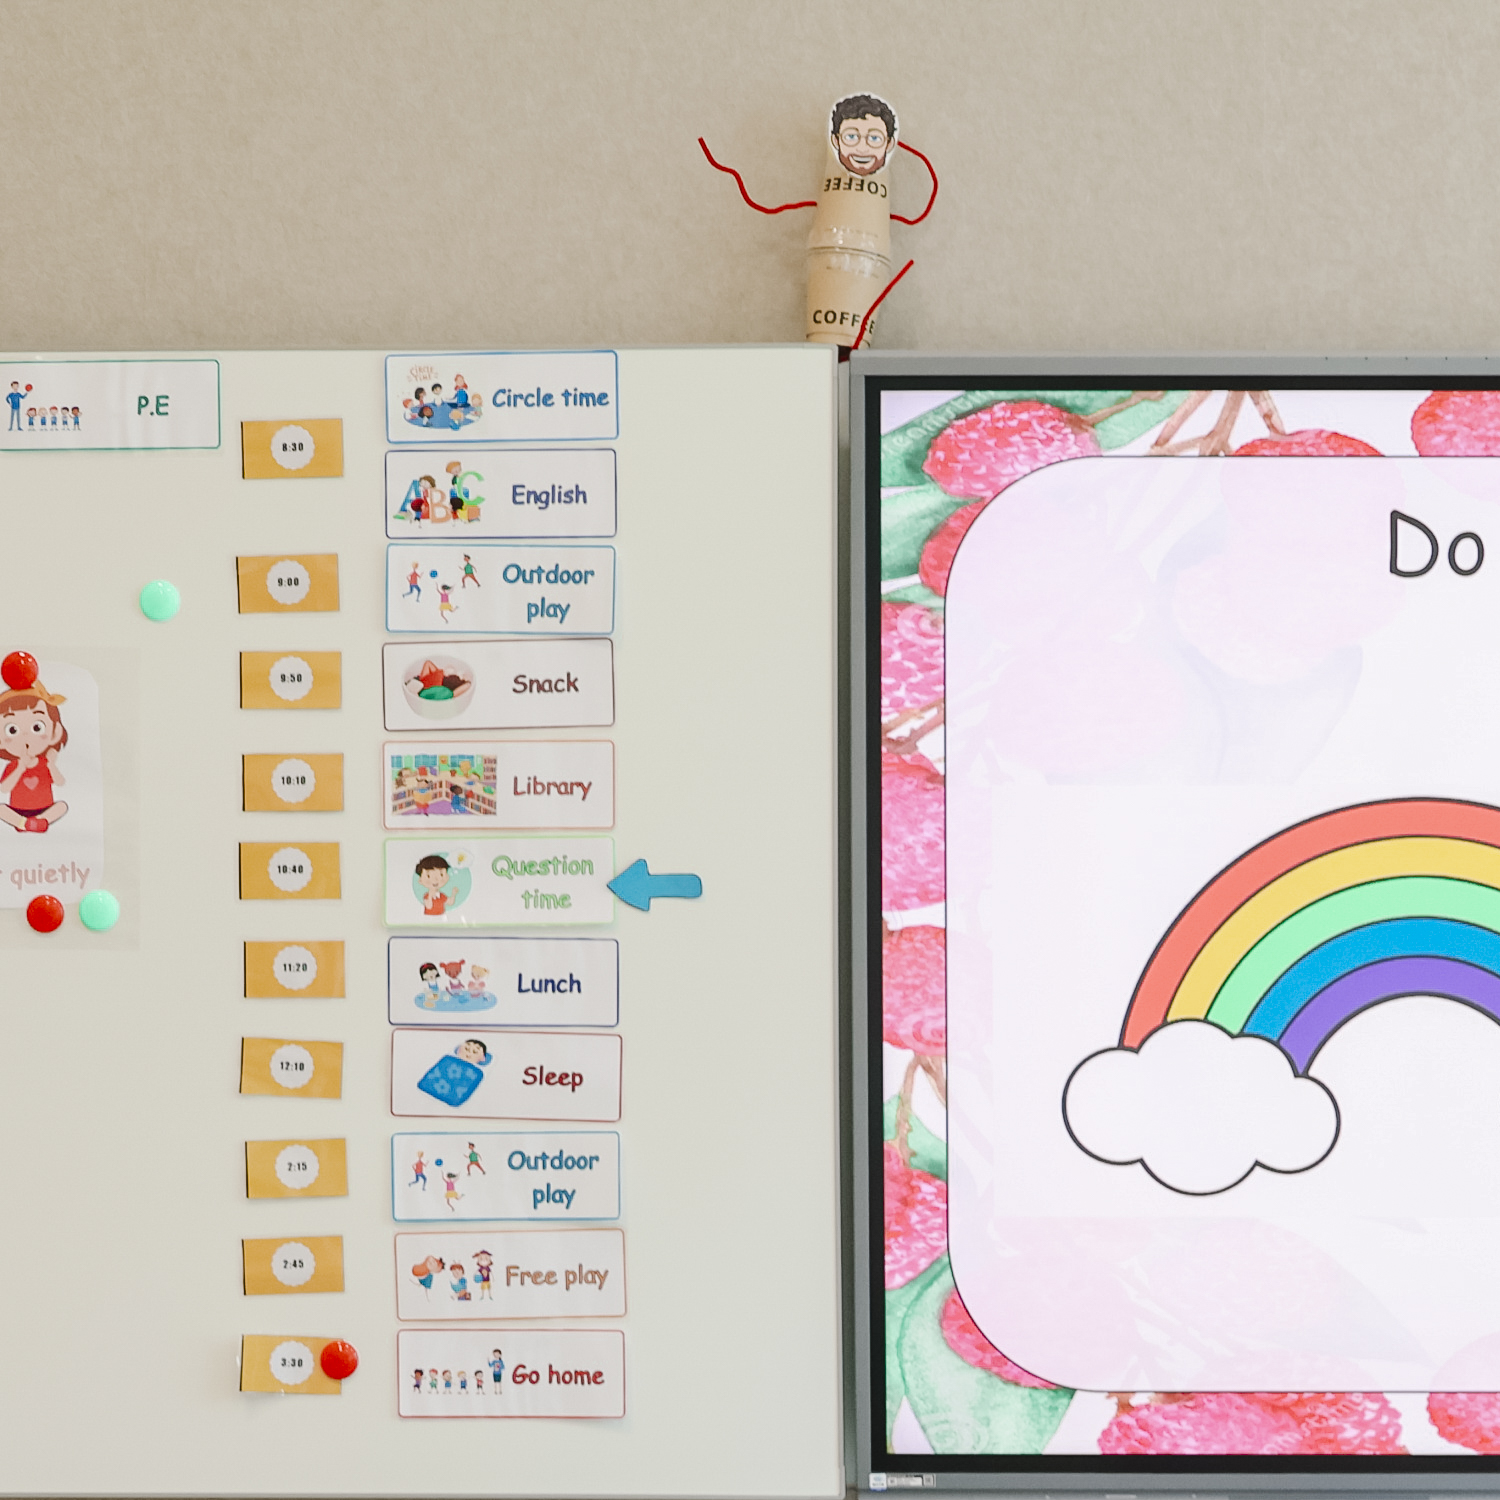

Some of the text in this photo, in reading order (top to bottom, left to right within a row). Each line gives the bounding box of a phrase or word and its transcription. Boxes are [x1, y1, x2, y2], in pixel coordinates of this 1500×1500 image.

[813, 309, 875, 335] COFFE
[136, 395, 170, 417] P.E
[492, 387, 610, 408] Circle time
[281, 442, 304, 452] 8:30
[512, 484, 587, 510] English
[1389, 509, 1485, 578] Do
[277, 577, 300, 587] 9:00
[501, 564, 595, 585] Outdoor
[526, 598, 570, 624] play
[280, 673, 302, 683] 9:50
[511, 673, 580, 694] Snack
[280, 775, 307, 785] 10:10
[512, 776, 592, 801] Library
[10, 861, 90, 890] quietly
[276, 864, 303, 875] 10:40
[491, 855, 594, 878] Question
[521, 889, 572, 910] time
[283, 963, 308, 973] 11:20
[517, 973, 582, 994] Lunch
[280, 1062, 305, 1072] 12:10
[522, 1067, 584, 1092] Sleep
[287, 1162, 307, 1172] 2:15
[507, 1151, 600, 1171] Outdoor
[533, 1185, 576, 1209] play
[283, 1259, 304, 1270] 2:45
[506, 1265, 609, 1290] Free play
[281, 1358, 303, 1368] 3:30
[511, 1365, 605, 1386] Go home
